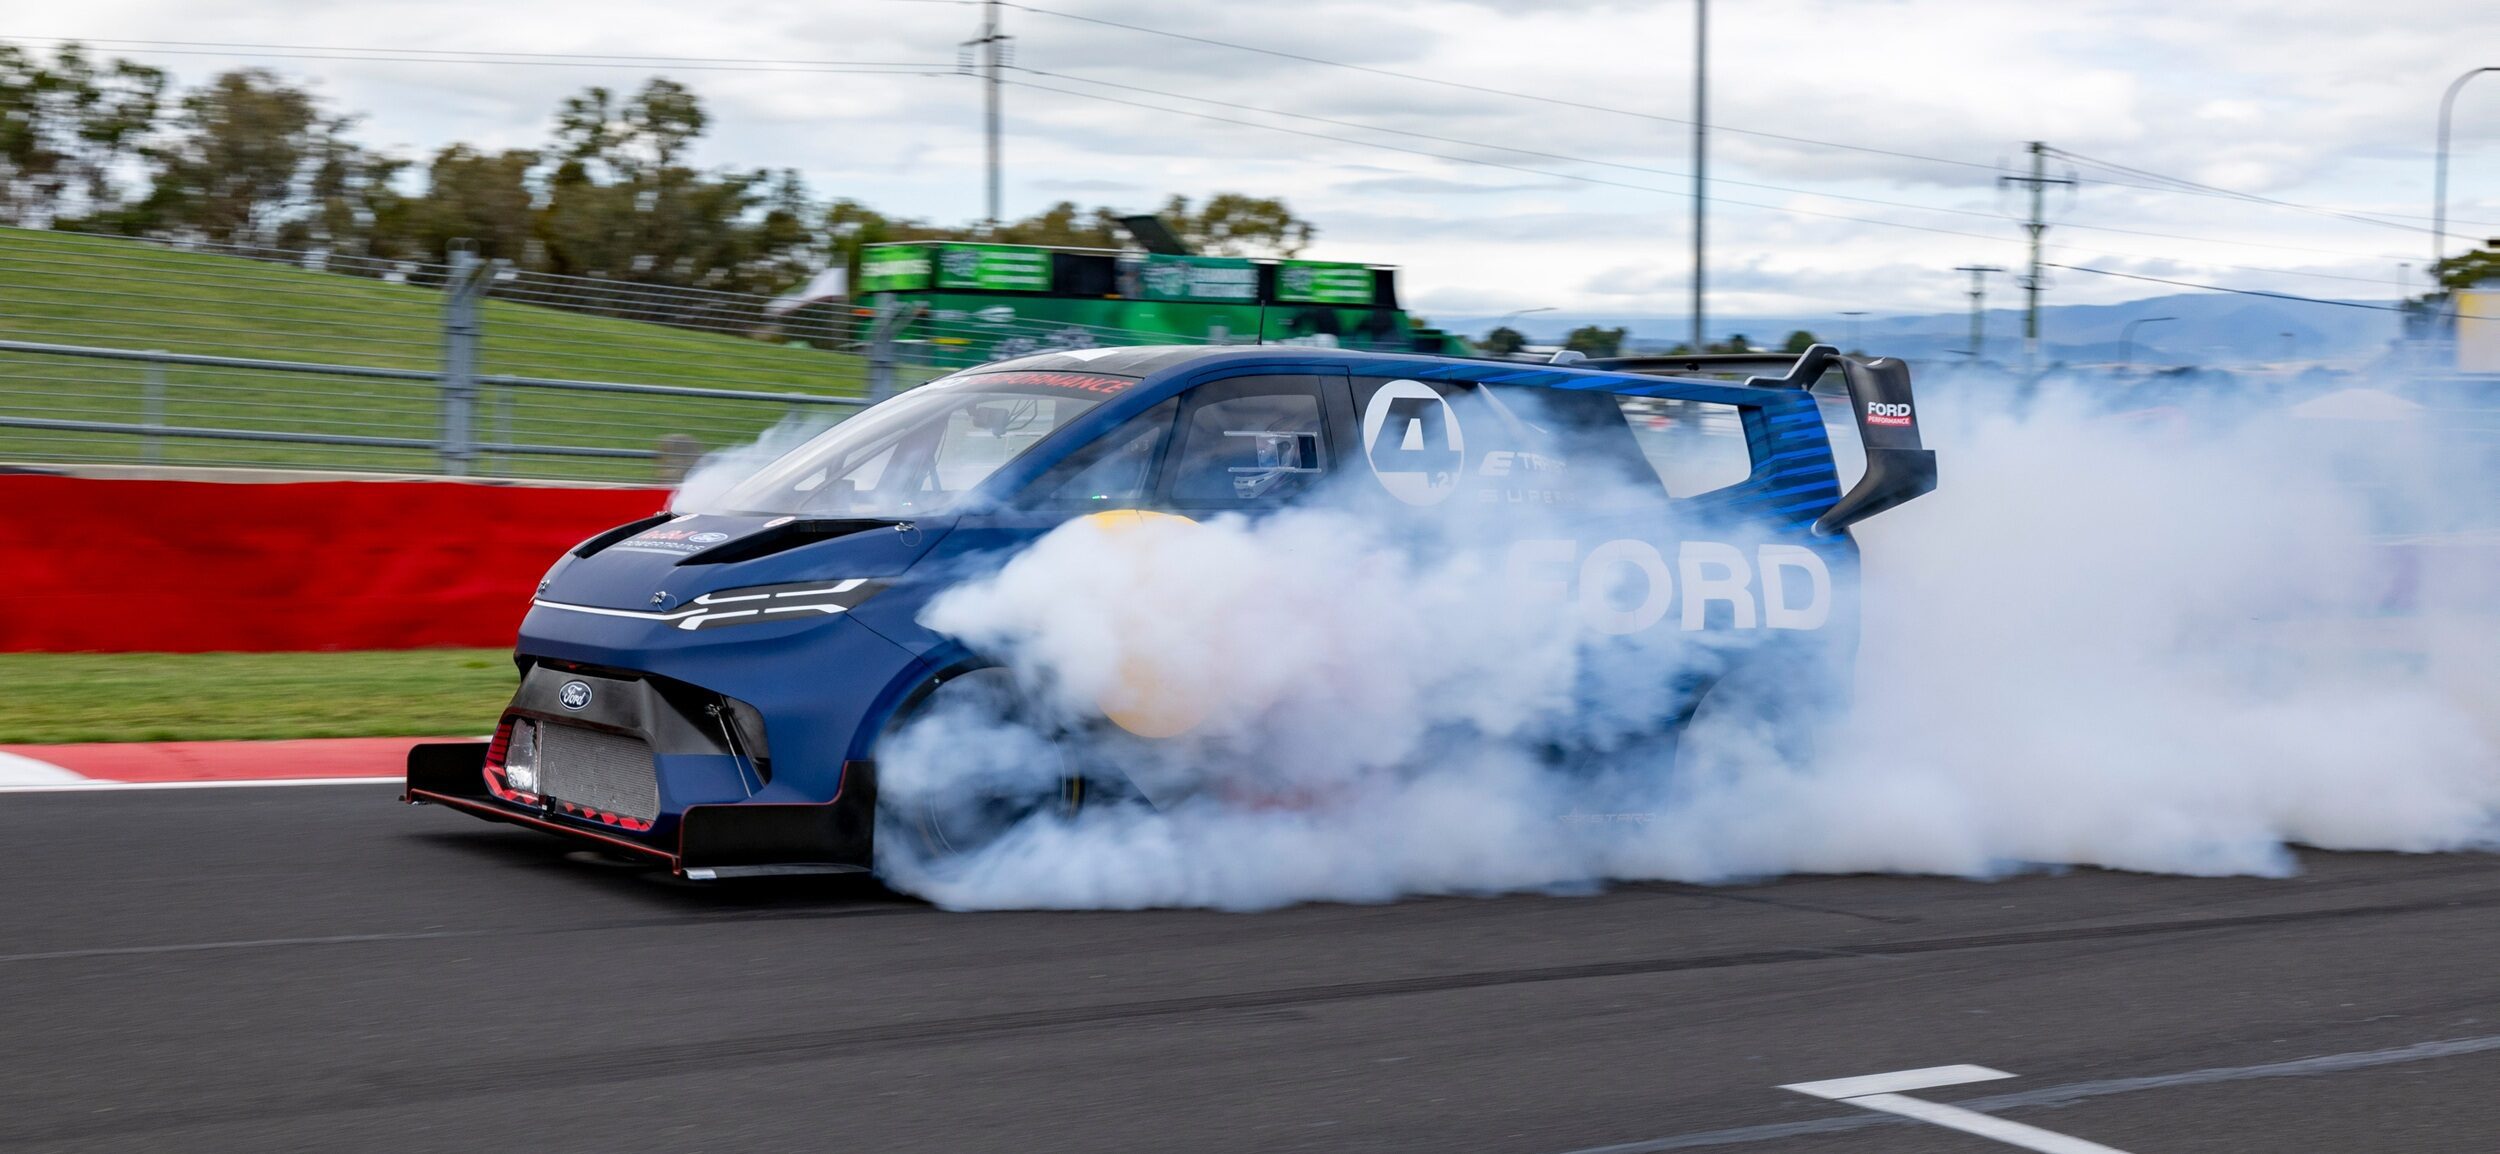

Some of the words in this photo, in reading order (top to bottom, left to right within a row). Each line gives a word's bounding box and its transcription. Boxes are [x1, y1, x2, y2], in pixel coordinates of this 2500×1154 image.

[1868, 401, 1911, 417] FORD
[1868, 416, 1910, 425] PERFORMANCE
[1506, 539, 1832, 635] FORD
[562, 684, 588, 707] Ford
